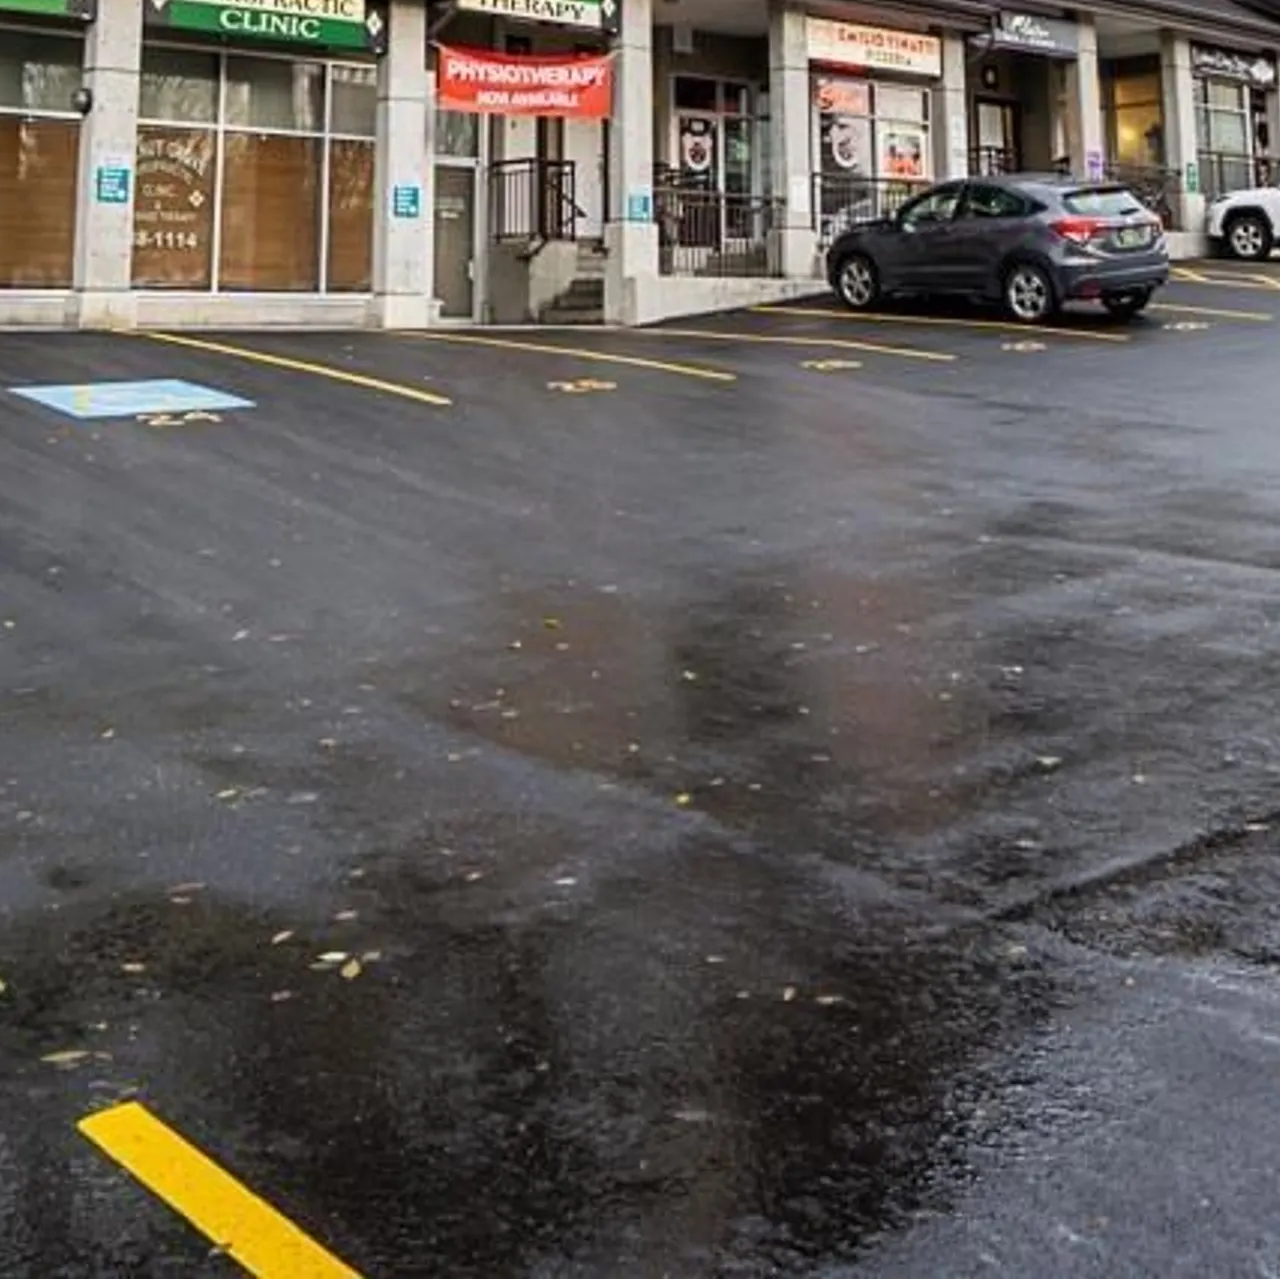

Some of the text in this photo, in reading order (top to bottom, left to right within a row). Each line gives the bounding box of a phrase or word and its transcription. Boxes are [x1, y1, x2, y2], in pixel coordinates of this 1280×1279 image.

[220, 9, 320, 39] CLINIC
[446, 58, 606, 86] PHYSIOTHERAPY
[477, 91, 509, 105] NOW
